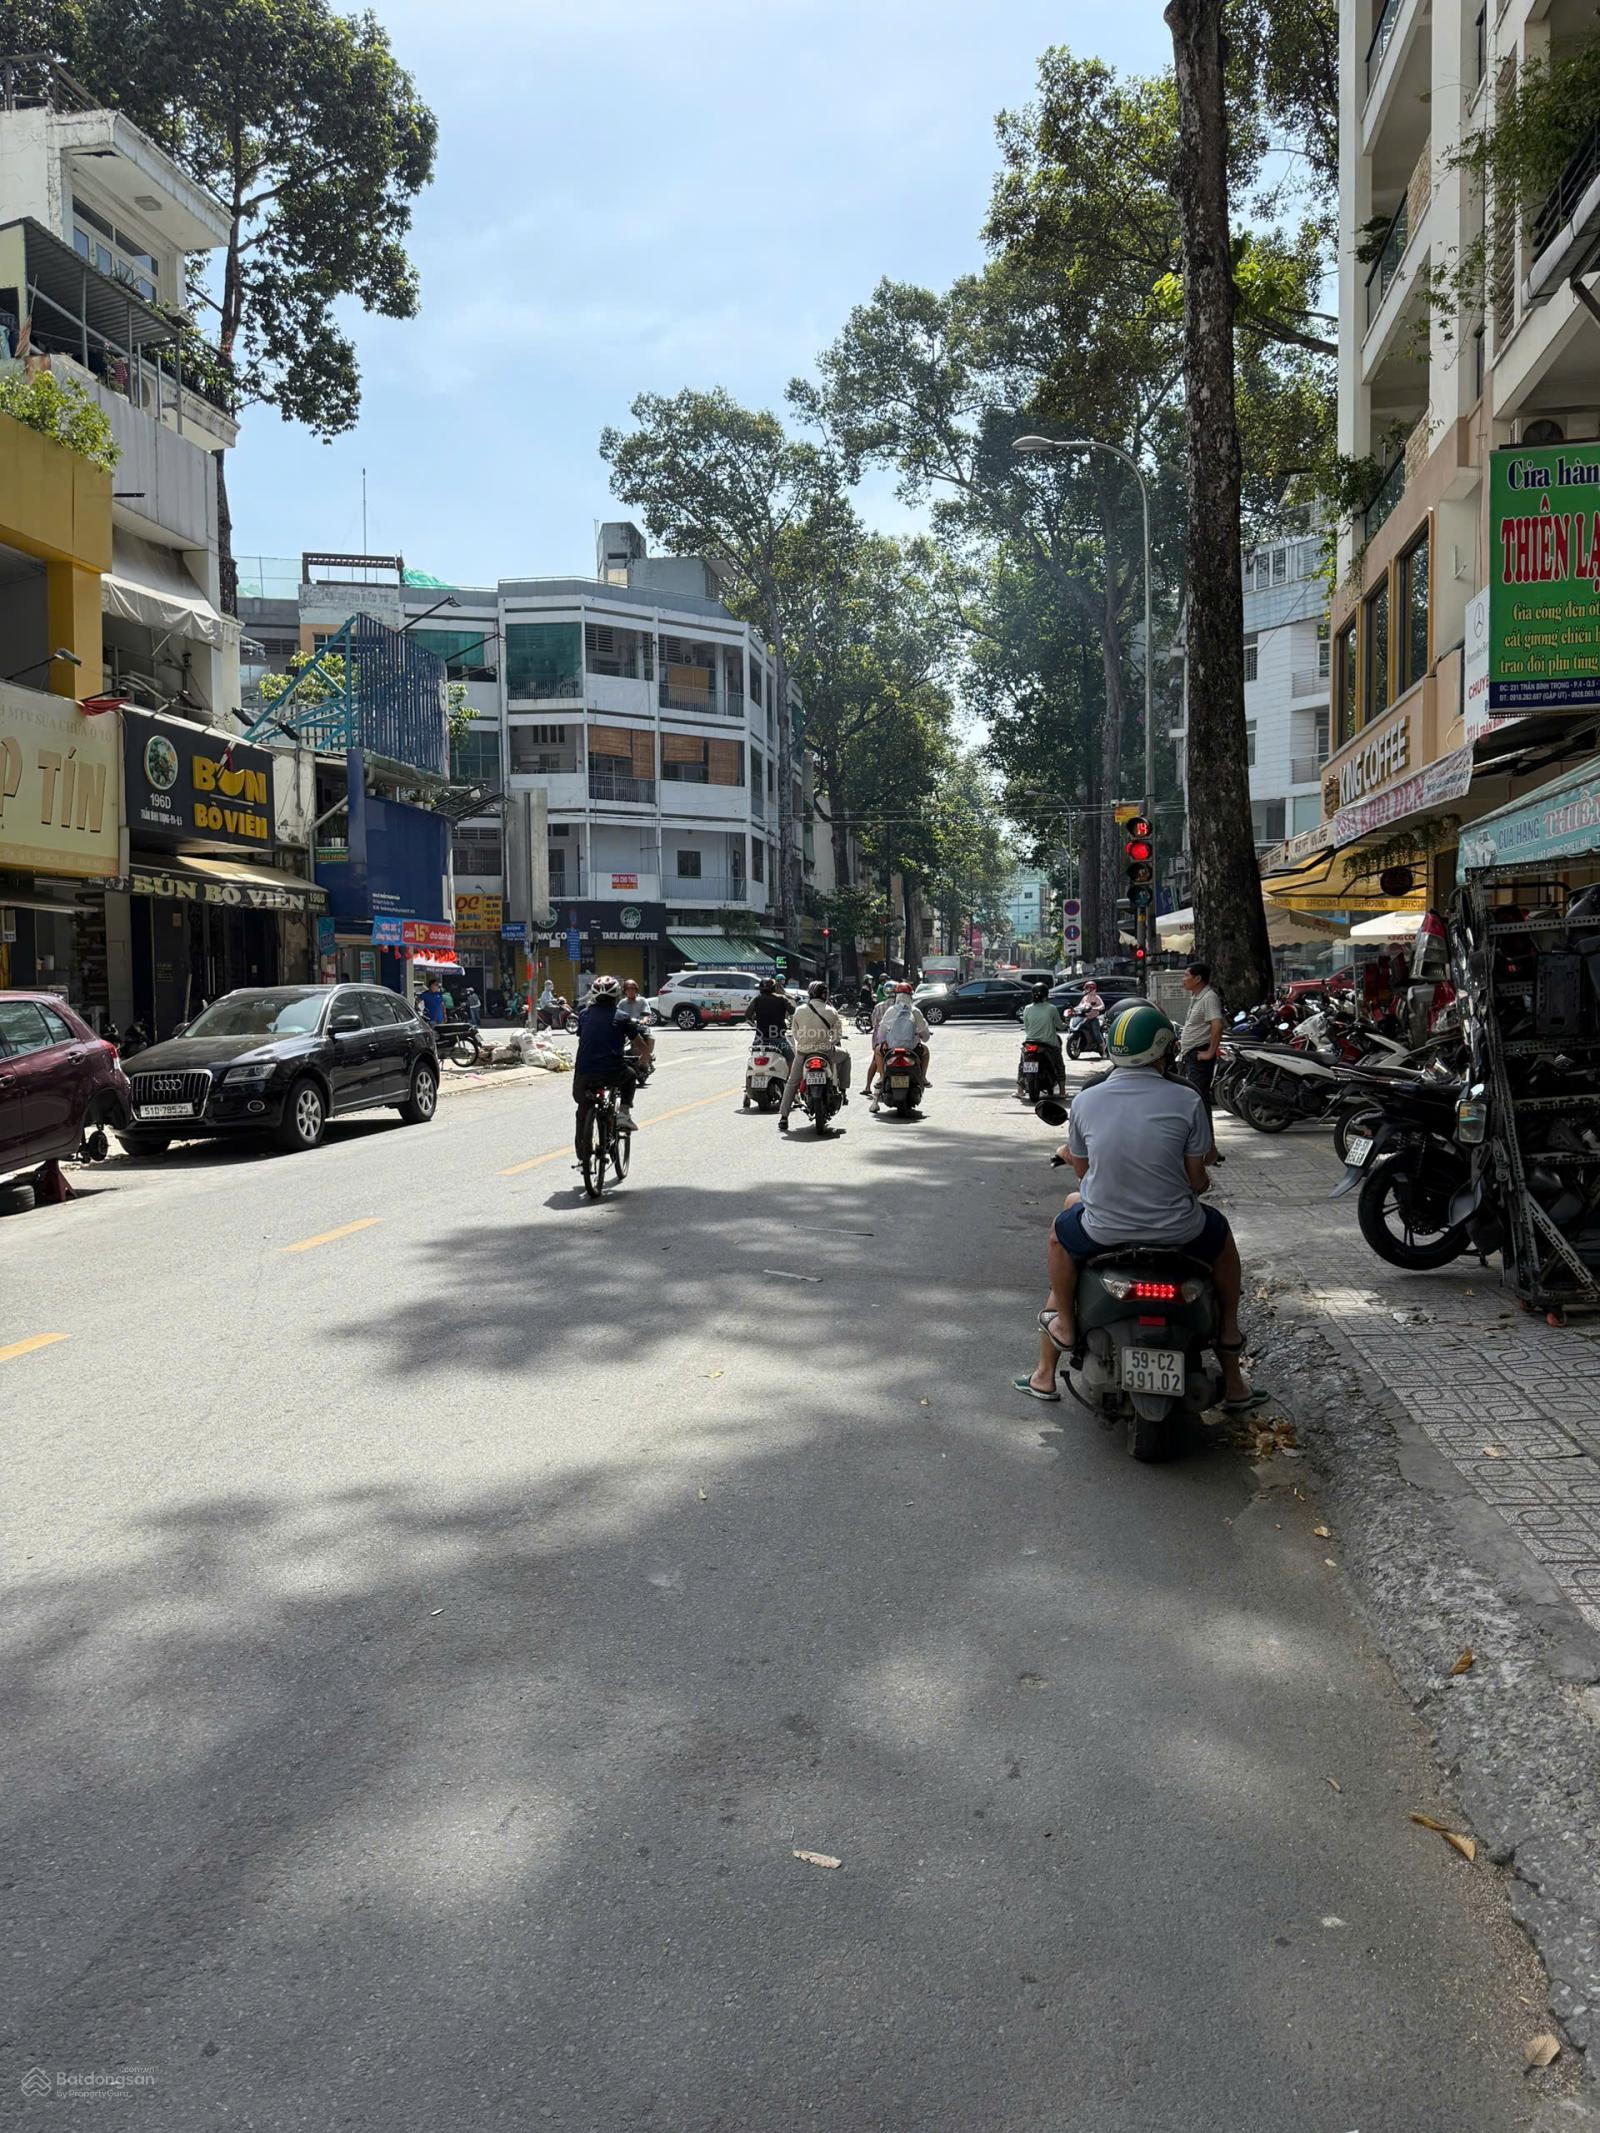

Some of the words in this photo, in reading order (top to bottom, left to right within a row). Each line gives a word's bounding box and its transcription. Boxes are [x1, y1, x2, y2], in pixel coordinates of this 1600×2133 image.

[1507, 458, 1552, 491] Cửa
[1501, 493, 1571, 584] THIÊN
[1513, 602, 1532, 620] Gia
[1535, 602, 1562, 623] công
[1504, 628, 1521, 648] cắt
[1500, 658, 1523, 674] trao
[1527, 654, 1545, 673] đổi
[1548, 654, 1569, 676] phụ
[1573, 653, 1599, 672] tùng
[1339, 751, 1362, 807] KING
[1363, 716, 1407, 790] COFFEE
[38, 746, 107, 833] TÍN
[150, 793, 172, 809] 196D
[194, 801, 223, 830] BÒ
[223, 809, 268, 839] VIÊN
[131, 872, 198, 901] BÚN
[204, 882, 242, 906] BÒ
[246, 886, 306, 911] VIÊN
[635, 931, 659, 940] COFFEE
[1131, 1351, 1175, 1372] 59-C2
[1126, 1370, 1181, 1392] 391.02
